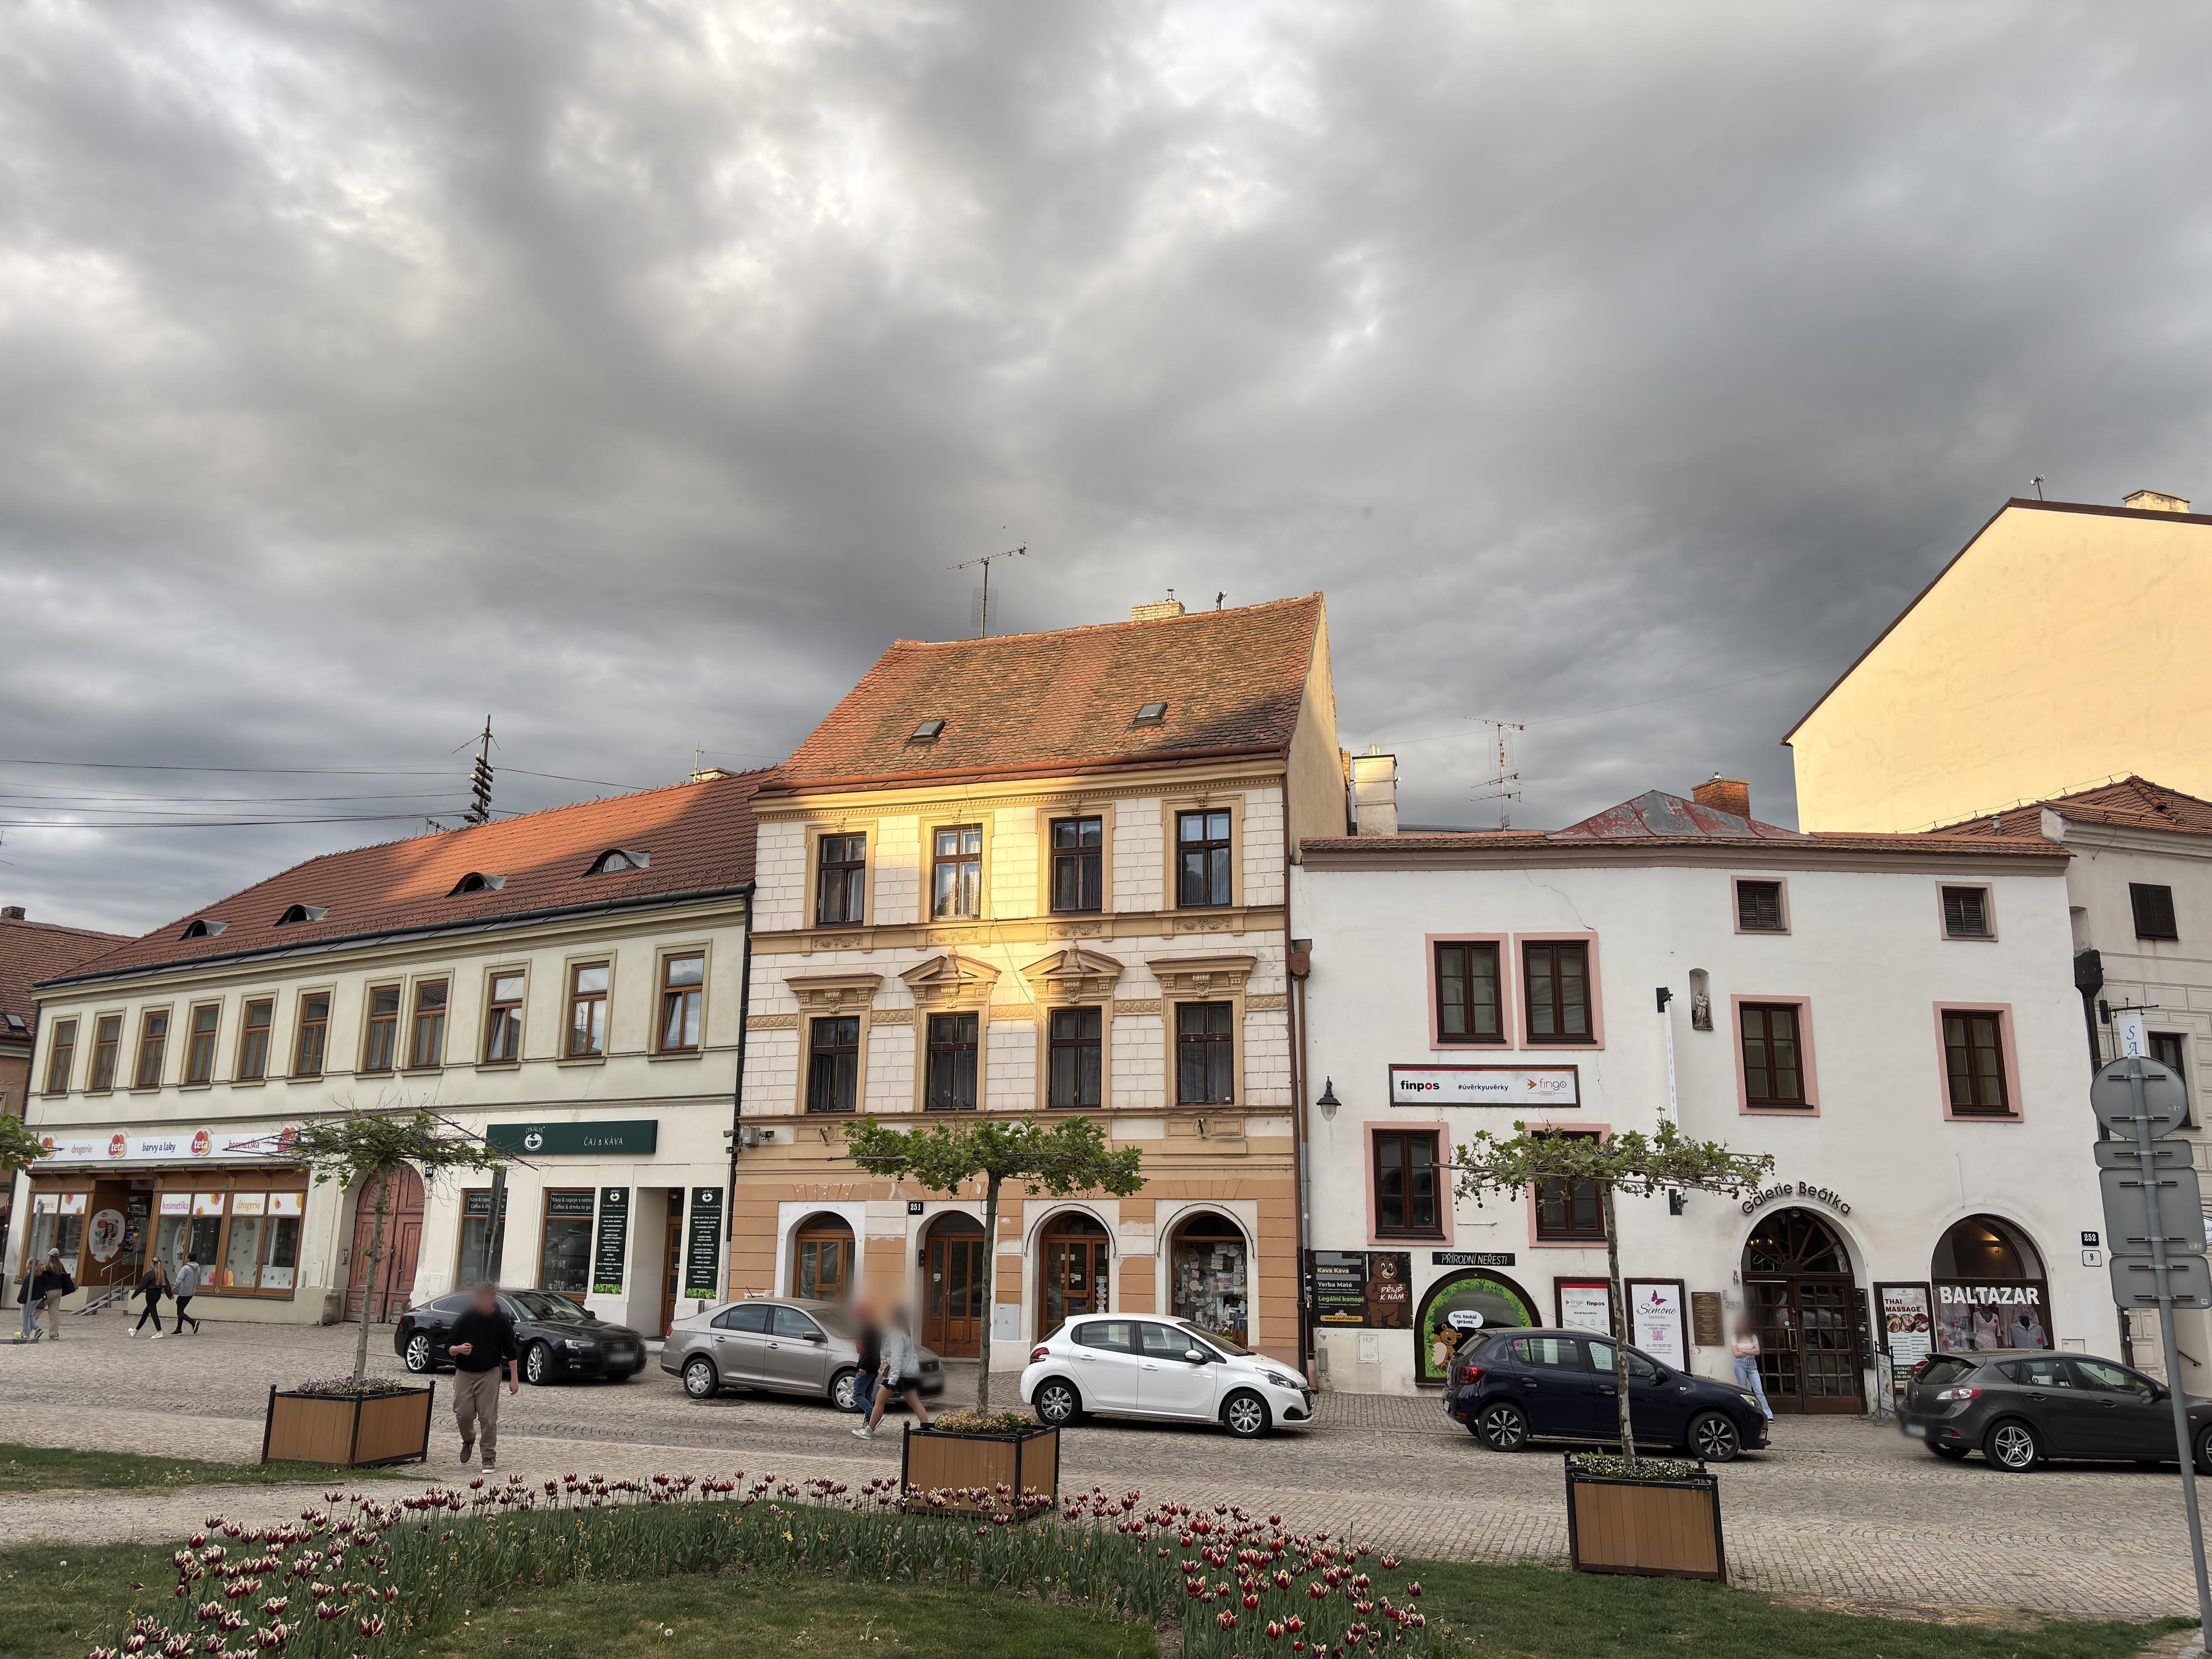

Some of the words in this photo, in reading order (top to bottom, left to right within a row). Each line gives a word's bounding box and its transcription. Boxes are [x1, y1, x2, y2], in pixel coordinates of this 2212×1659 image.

[2127, 1025, 2139, 1055] SA
[1400, 1080, 1440, 1092] finpos
[1540, 1078, 1567, 1091] fingo
[194, 1140, 208, 1149] teta
[584, 1136, 596, 1146] ČAJ
[604, 1136, 623, 1145] KÁVA
[71, 1145, 92, 1156] drogerie
[111, 1142, 124, 1152] teta
[142, 1143, 158, 1153] barvy
[163, 1142, 176, 1152] laky
[1742, 1182, 1793, 1214] Galerie
[1798, 1181, 1851, 1215] Beátka
[162, 1201, 189, 1209] kosmetika
[237, 1200, 260, 1211] drogerie
[2084, 1233, 2096, 1242] 252
[1441, 1254, 1477, 1265] PŘÍRODNÍ
[1478, 1254, 1507, 1265] NEŘESTI
[1387, 1292, 1404, 1300] NÁM
[1939, 1286, 2039, 1305] BALTAZAR
[1636, 1303, 1676, 1314] Simone
